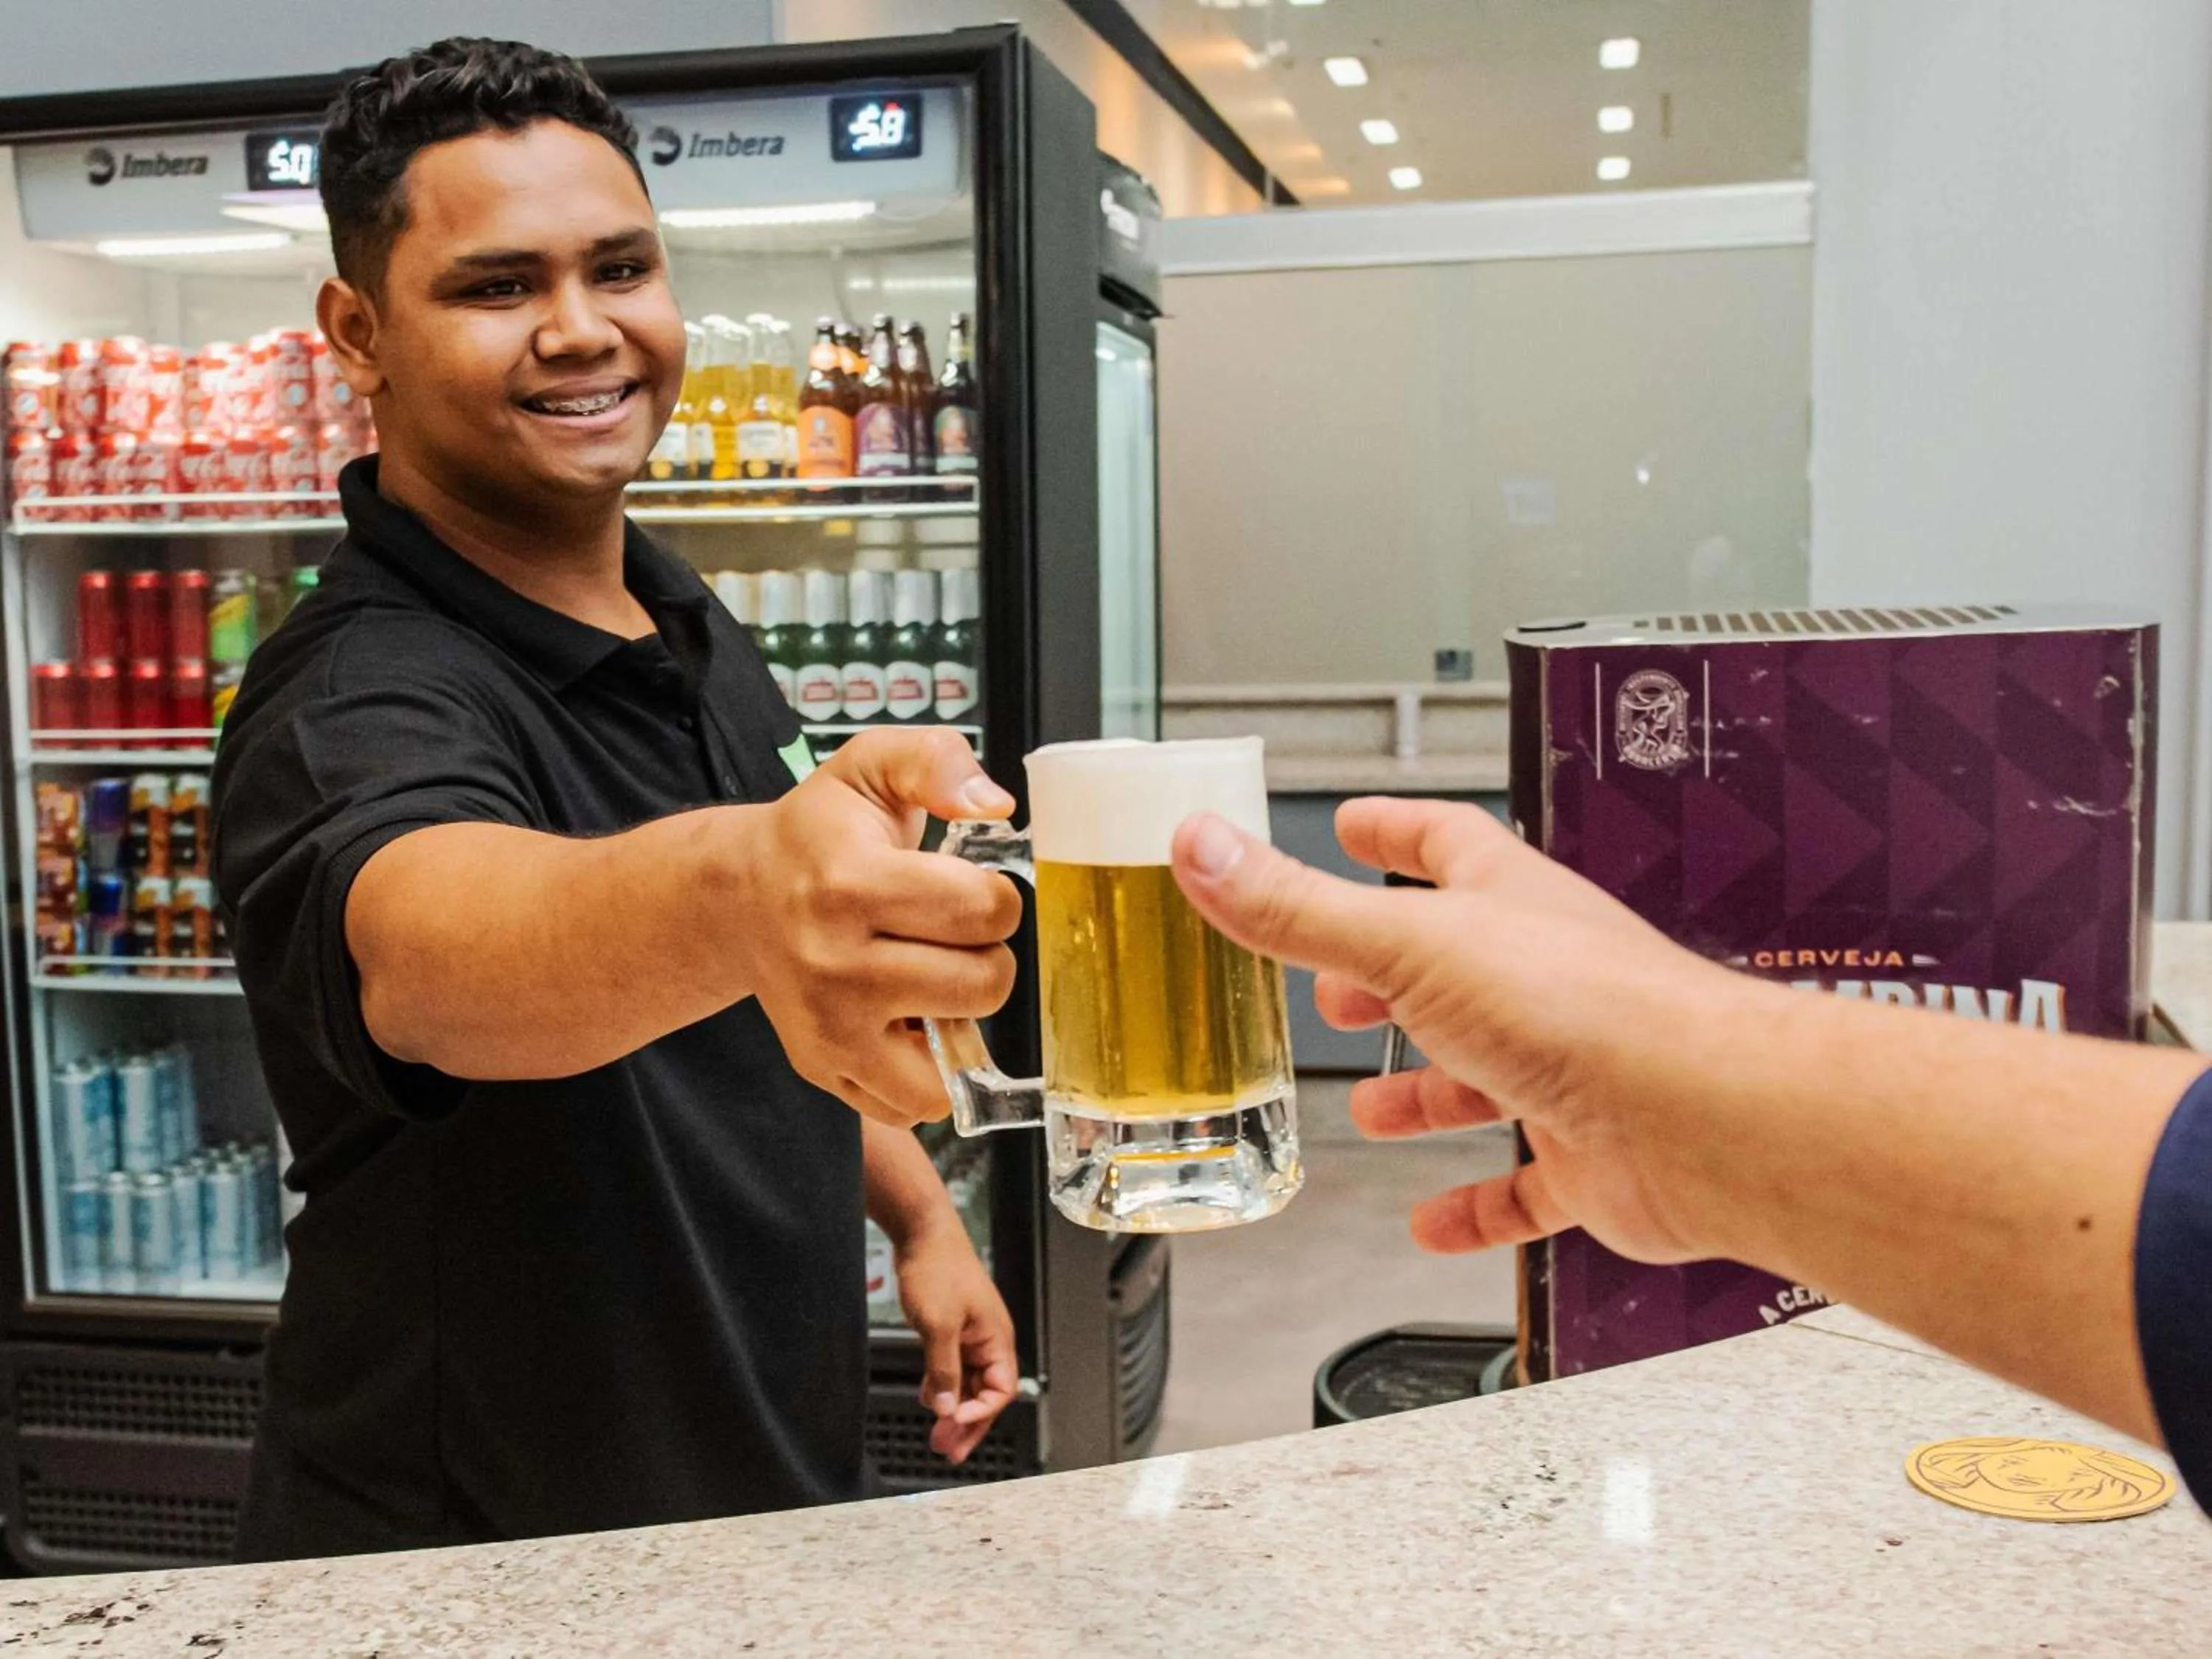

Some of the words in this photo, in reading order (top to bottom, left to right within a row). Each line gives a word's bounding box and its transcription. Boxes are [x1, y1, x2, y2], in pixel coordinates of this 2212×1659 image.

[687, 131, 785, 159] Imbera
[120, 150, 210, 179] Imbera
[1753, 949, 1905, 968] CERVEJA
